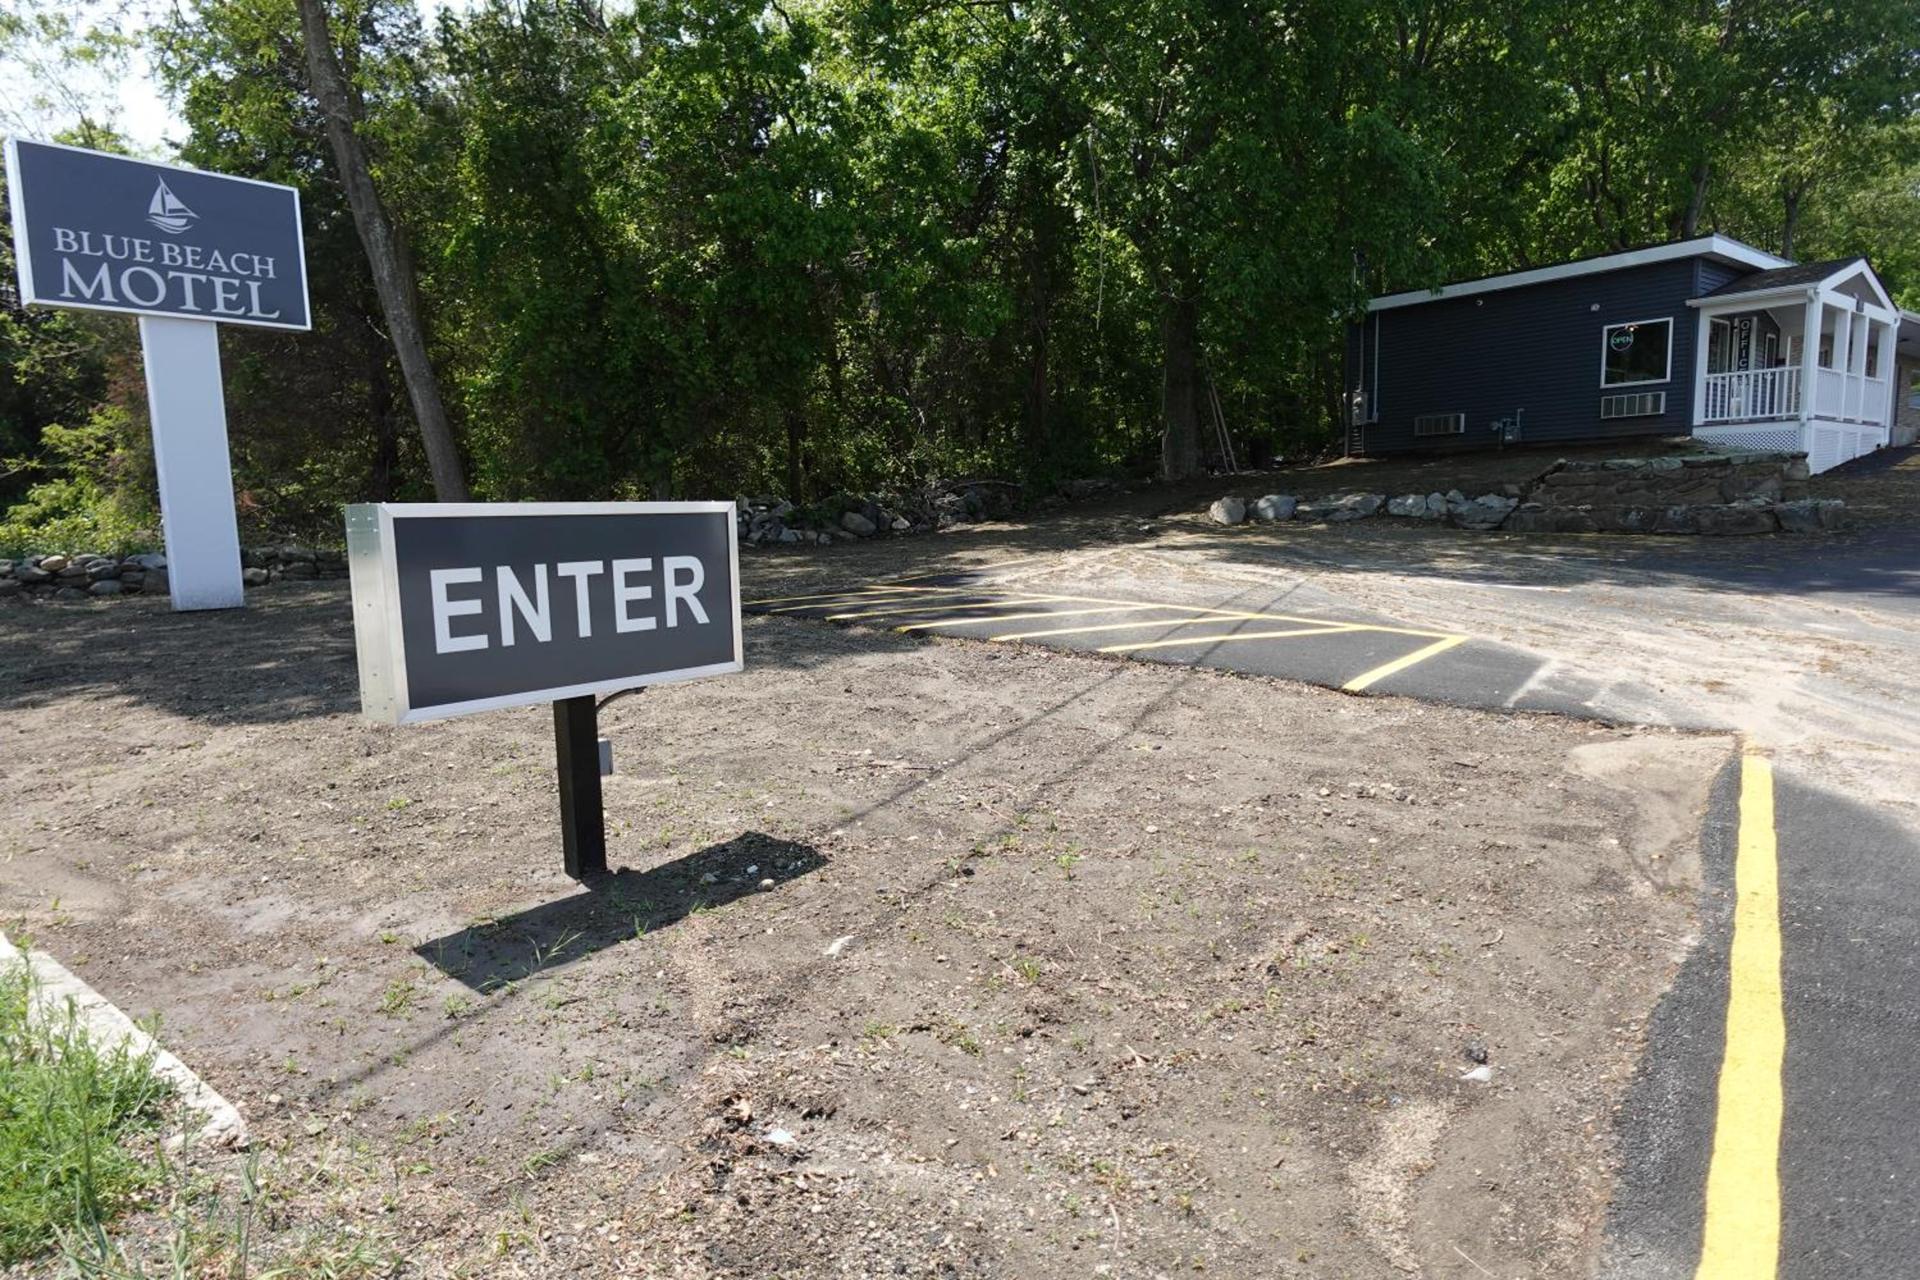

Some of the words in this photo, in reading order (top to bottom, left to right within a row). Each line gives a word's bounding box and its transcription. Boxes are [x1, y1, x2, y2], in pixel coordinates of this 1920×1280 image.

[54, 227, 154, 262] BLUE
[161, 243, 276, 279] BEACH
[59, 257, 281, 319] MOTEL
[1612, 336, 1633, 345] OPEN
[429, 555, 711, 655] ENTER
